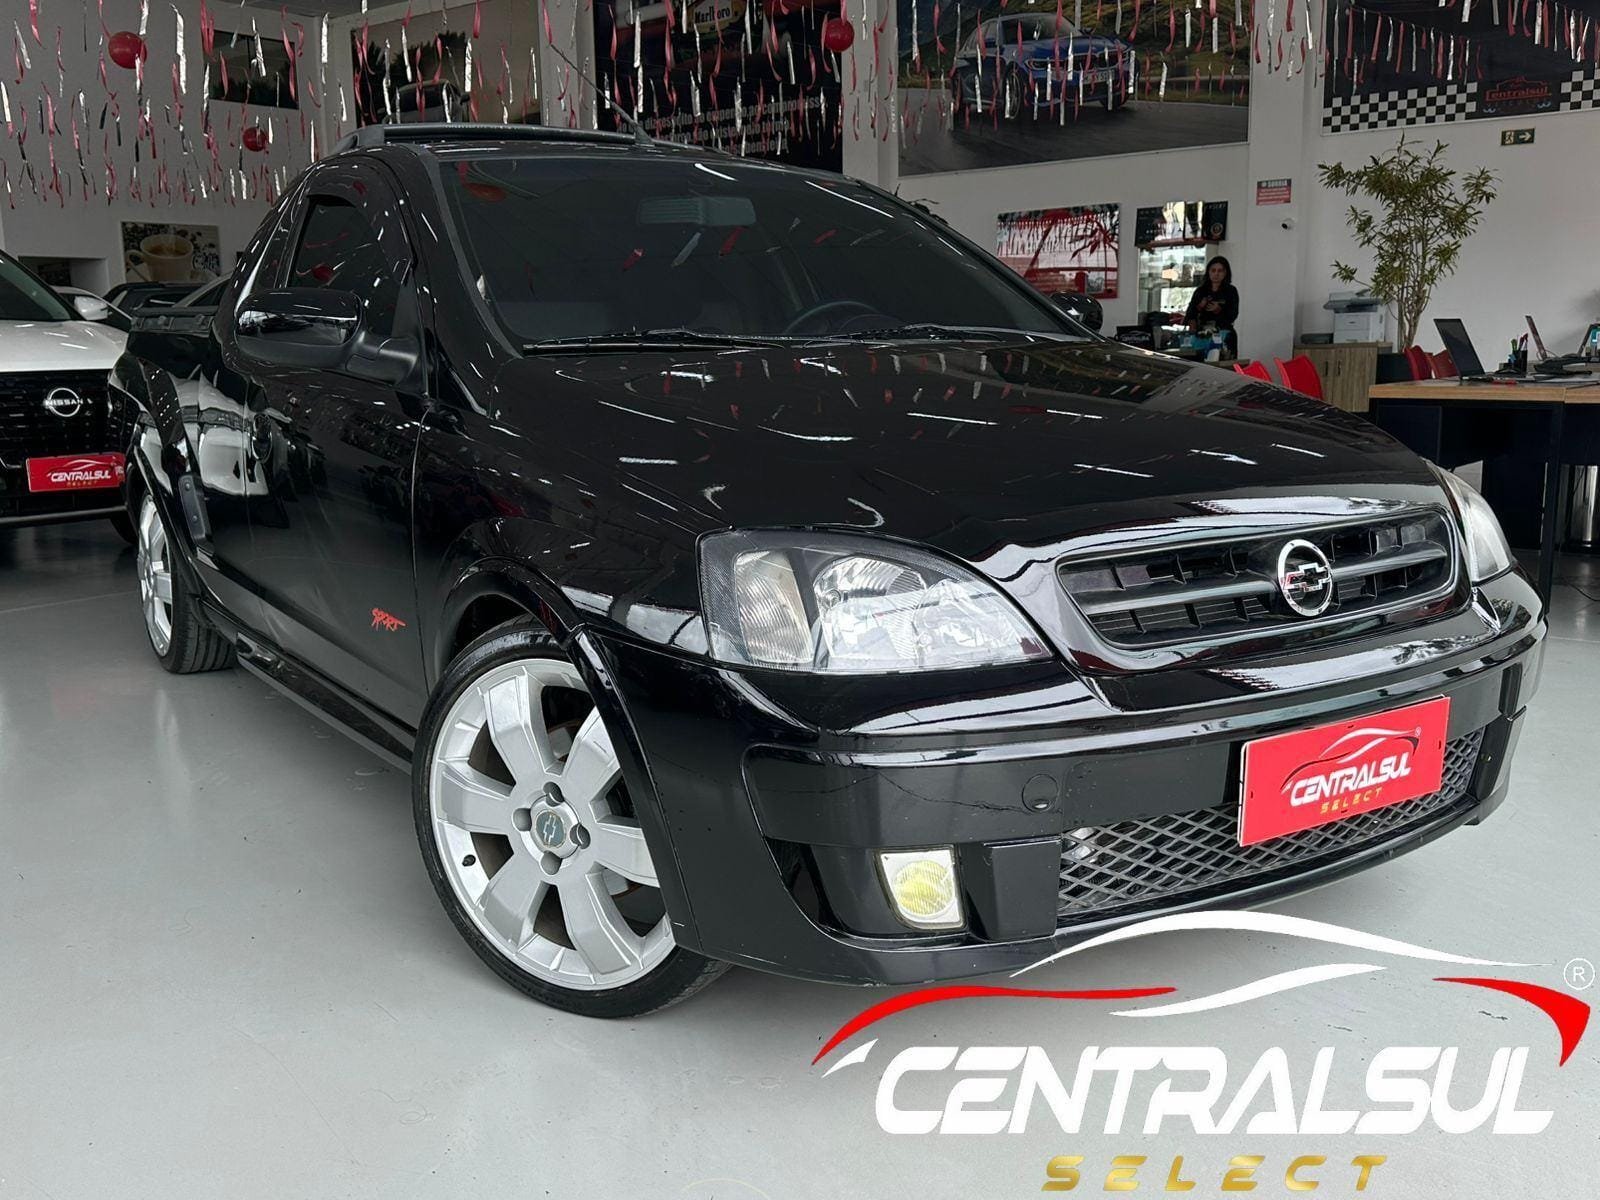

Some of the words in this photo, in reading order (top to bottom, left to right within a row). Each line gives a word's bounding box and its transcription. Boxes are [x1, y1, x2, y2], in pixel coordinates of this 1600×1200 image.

[45, 399, 83, 407] NISSAN
[51, 470, 111, 482] CENTRALSUL
[1290, 752, 1411, 807] CENTRALSUL
[1320, 787, 1383, 815] SELECT
